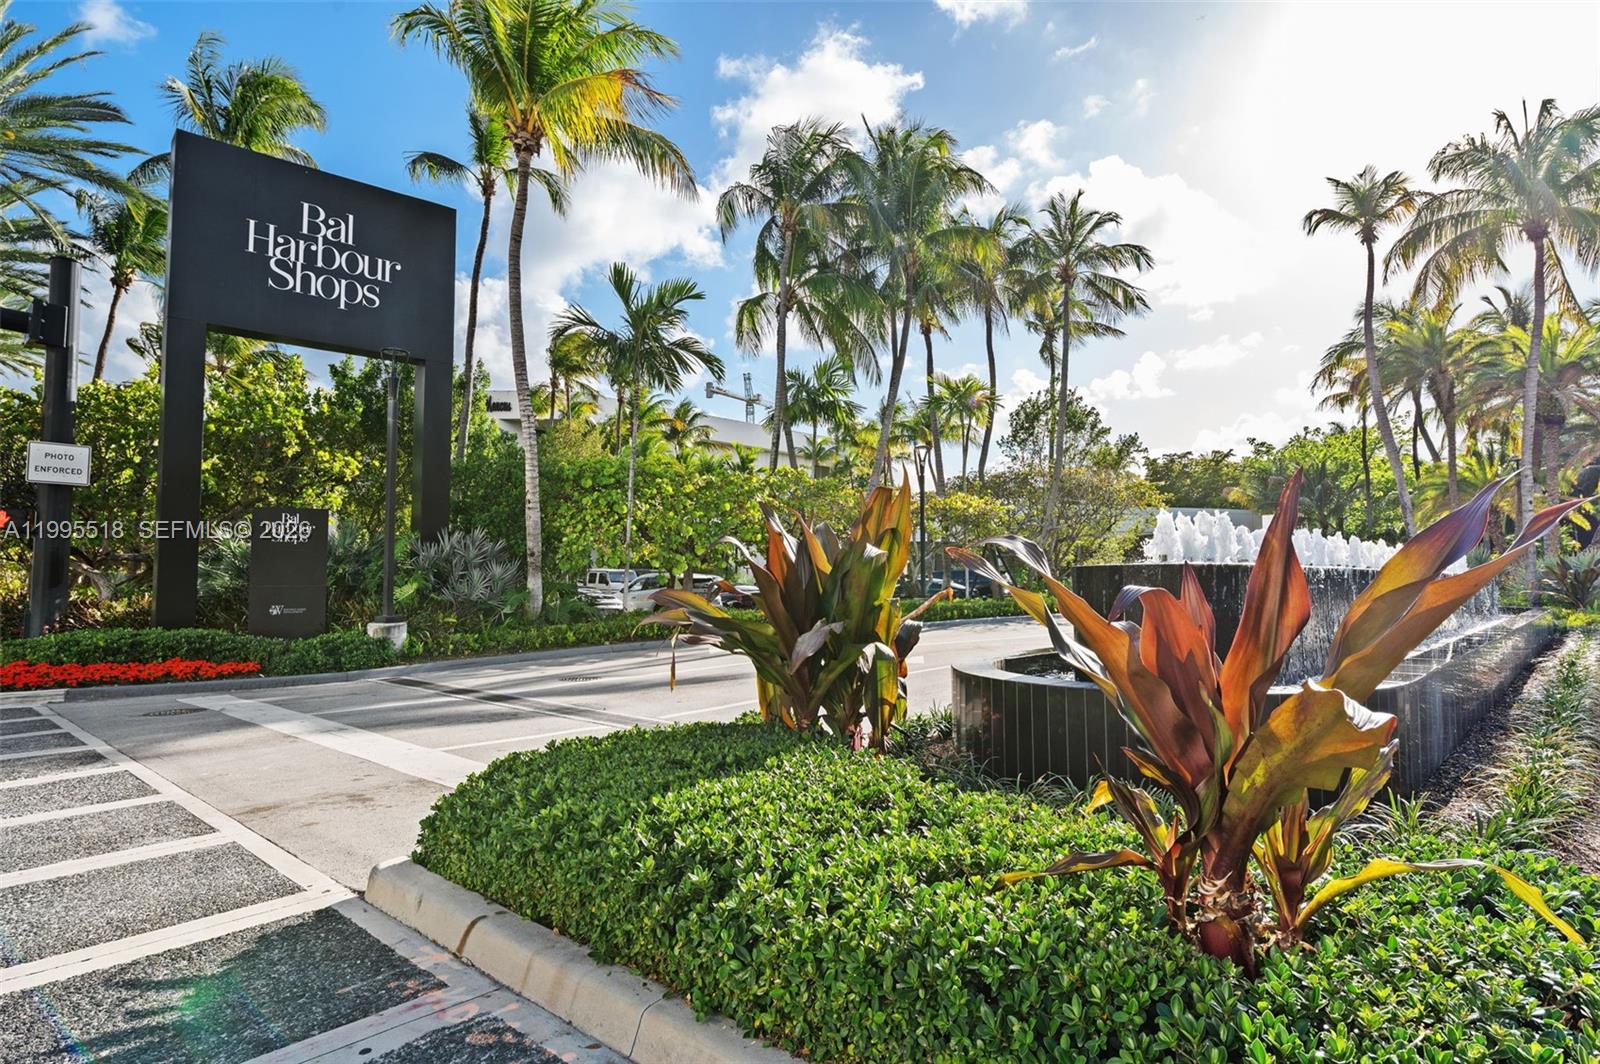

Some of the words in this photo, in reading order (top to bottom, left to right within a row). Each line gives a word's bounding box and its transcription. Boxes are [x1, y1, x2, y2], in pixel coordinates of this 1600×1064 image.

[300, 201, 356, 246] Bal
[245, 218, 402, 283] Harbour
[268, 256, 380, 310] Shops
[34, 465, 83, 475] ENFORCED
[44, 452, 75, 461] PHOTO
